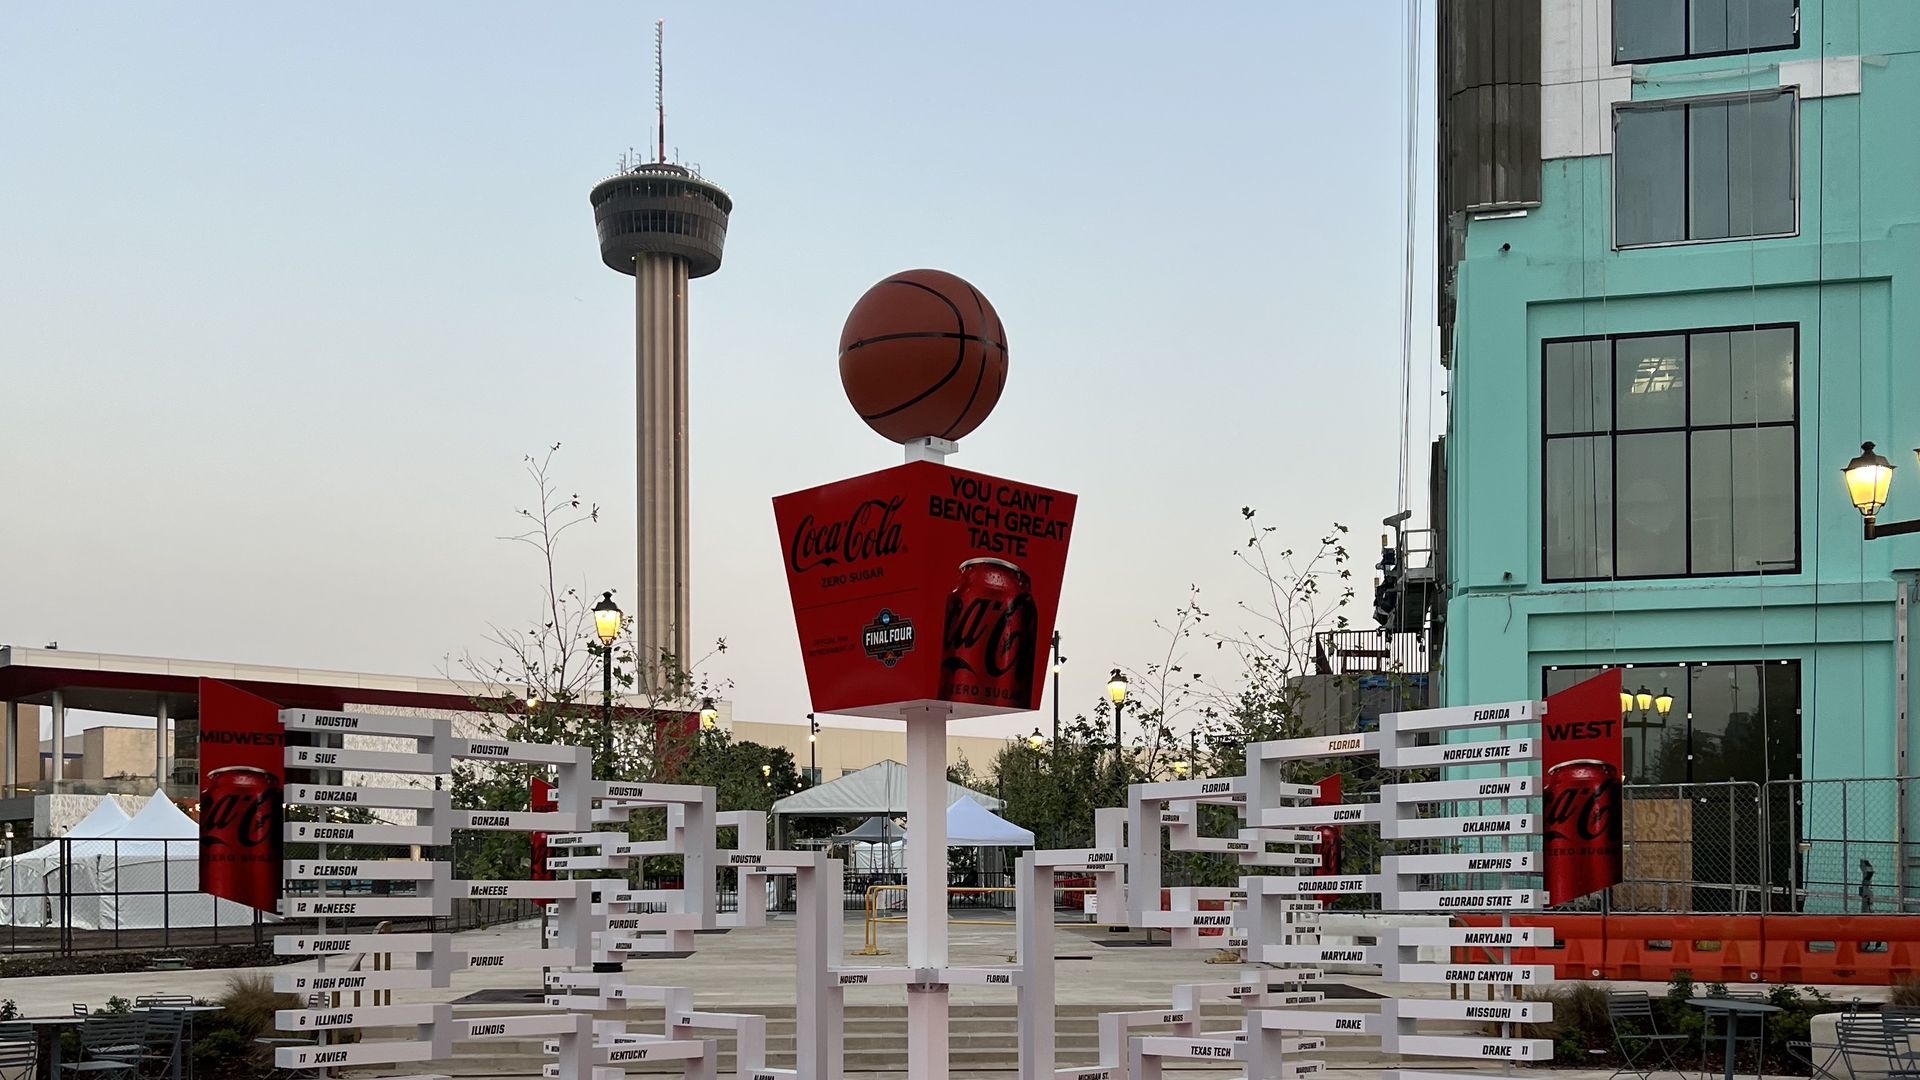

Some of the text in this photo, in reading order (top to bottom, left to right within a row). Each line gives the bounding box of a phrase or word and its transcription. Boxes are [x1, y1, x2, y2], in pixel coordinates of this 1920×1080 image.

[950, 475, 1055, 515] YOU CAN'T
[929, 495, 1068, 541] BENCH GREAT
[791, 495, 907, 573] Coca-Cola
[968, 527, 1028, 558] TASTE
[821, 567, 885, 588] ZERO SUGAR
[865, 630, 889, 646] FINAL
[889, 626, 913, 643] FOUR
[1473, 705, 1526, 721] FLORIDA 1
[301, 713, 359, 729] 1 HOUSTON
[1547, 720, 1617, 741] WEST
[200, 730, 285, 746] MIDWEST
[1328, 738, 1361, 751] FLORIDA
[470, 743, 510, 758] HOUSTON
[1443, 742, 1528, 760] NORFOLK STATE 16
[298, 751, 337, 764] 16 SIUE
[608, 786, 644, 798] HOUSTON
[1201, 782, 1230, 794] FLORIDA
[1478, 780, 1527, 795] UCONN 8
[299, 788, 358, 802] 8 GONZAGA
[471, 815, 510, 827] GONZAGA
[1333, 809, 1362, 821] UCONN
[1462, 818, 1527, 833] OKLAHOMA 9
[298, 827, 354, 840] 9 GEORGIA
[730, 854, 762, 864] HOUSTON
[1087, 852, 1114, 863] FLORIDA
[1468, 856, 1528, 870] MEMPHIS 5
[298, 865, 358, 876] 5 CLEMSON
[470, 885, 509, 896] McNEESE
[1298, 880, 1364, 892] COLORADO STATE
[1438, 894, 1530, 907] COLORADO STATE 12
[297, 902, 357, 914] 12 McNEESE
[608, 919, 640, 930] PURDUE
[1193, 915, 1231, 926] MARYLAND
[1464, 931, 1529, 944] MARYLAND 4
[297, 939, 352, 952] 4 PURDUE
[470, 955, 505, 967] PURDUE
[1320, 950, 1364, 962] MARYLAND
[839, 974, 868, 985] HOUSTON
[986, 974, 1010, 984] FLORIDA
[1445, 969, 1531, 982] GRAND CANYON 13
[296, 976, 367, 990] 13 HIGH POINT
[1232, 986, 1252, 994] OLE MISS
[1163, 1014, 1184, 1023] OLE MISS
[1465, 1006, 1528, 1019] MISSOURI 6
[299, 1013, 354, 1027] 6 ILLINOIS
[1335, 1018, 1362, 1030] DRAKE
[471, 1023, 506, 1036] ILLINOIS
[609, 1049, 648, 1061] KENTUCKY
[1190, 1045, 1232, 1058] TEXAS TECH
[1482, 1044, 1529, 1057] DRAKE 11
[299, 1051, 348, 1064] 11 XAVIER
